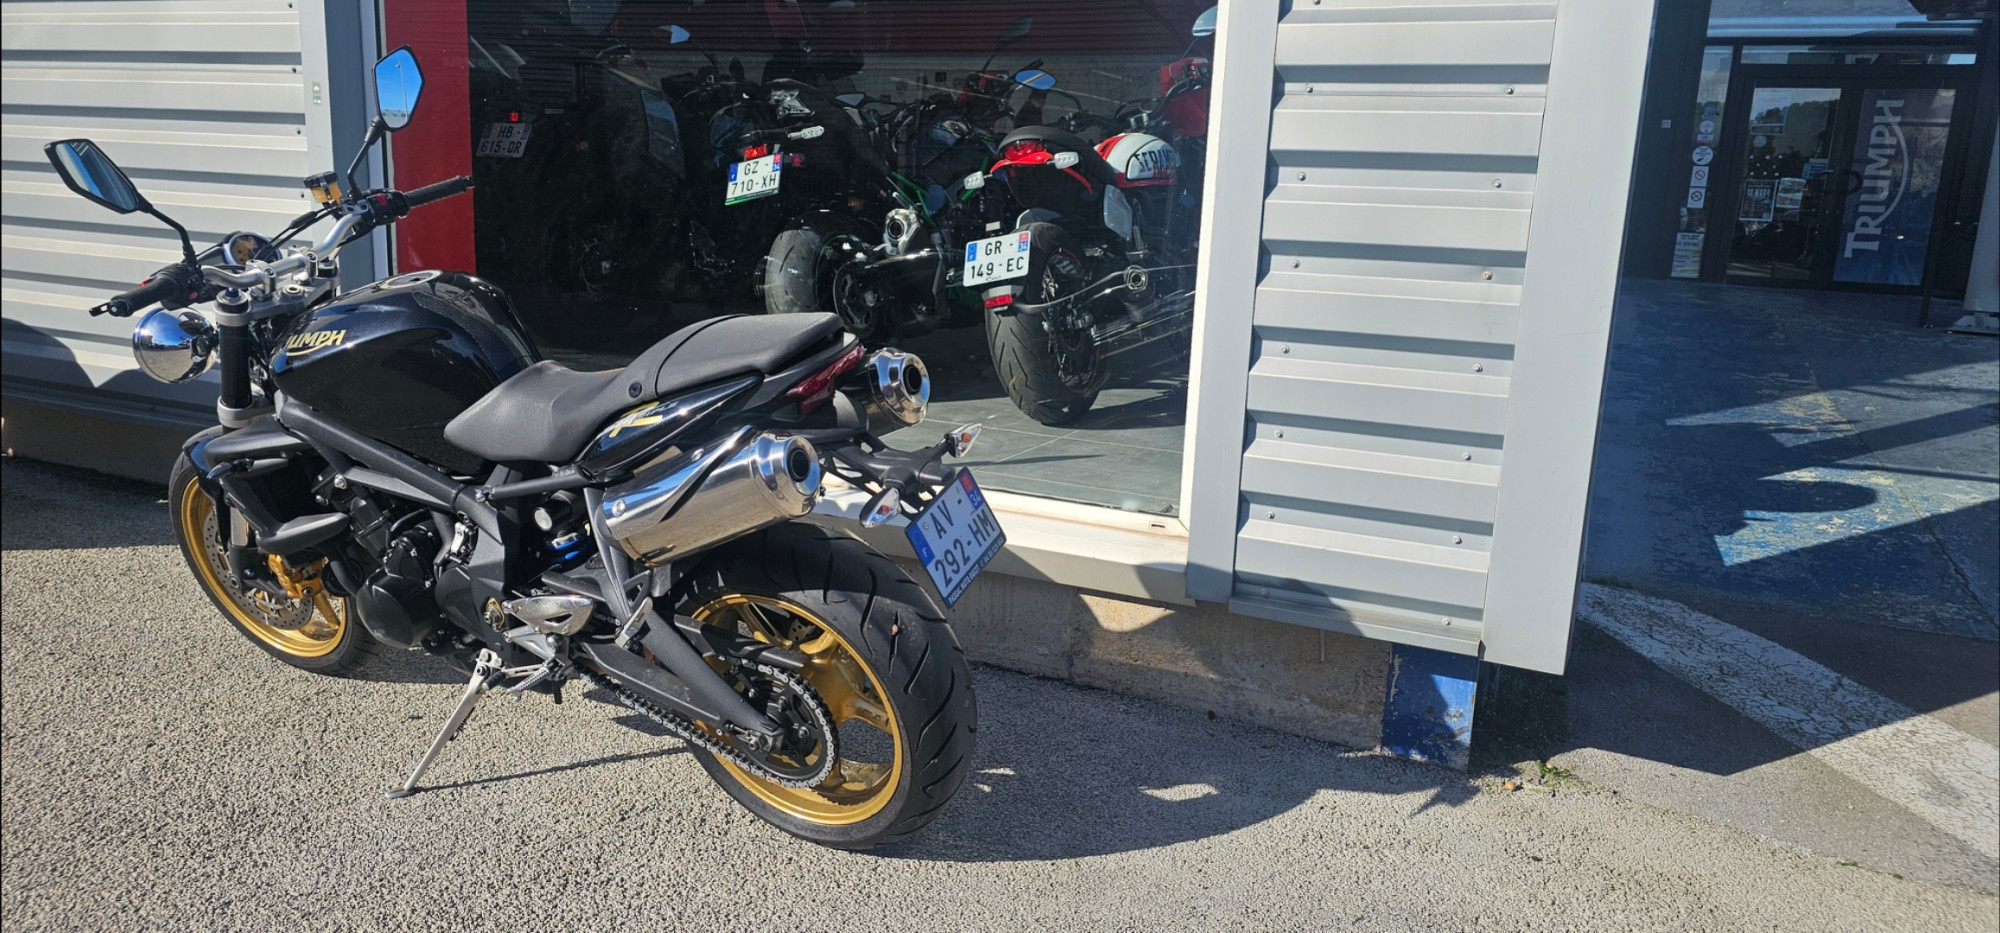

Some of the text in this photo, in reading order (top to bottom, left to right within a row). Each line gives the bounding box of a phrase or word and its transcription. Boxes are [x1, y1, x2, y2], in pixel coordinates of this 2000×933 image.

[497, 125, 514, 139] HB
[744, 161, 759, 176] GZ
[731, 173, 777, 196] 710-XH
[1844, 100, 1906, 258] TRIUMPH
[985, 241, 1002, 256] GR
[971, 256, 1024, 279] 149-EC
[970, 491, 982, 507] 34
[930, 500, 954, 540] AV
[921, 547, 928, 558] F
[934, 508, 996, 588] 292-HM
